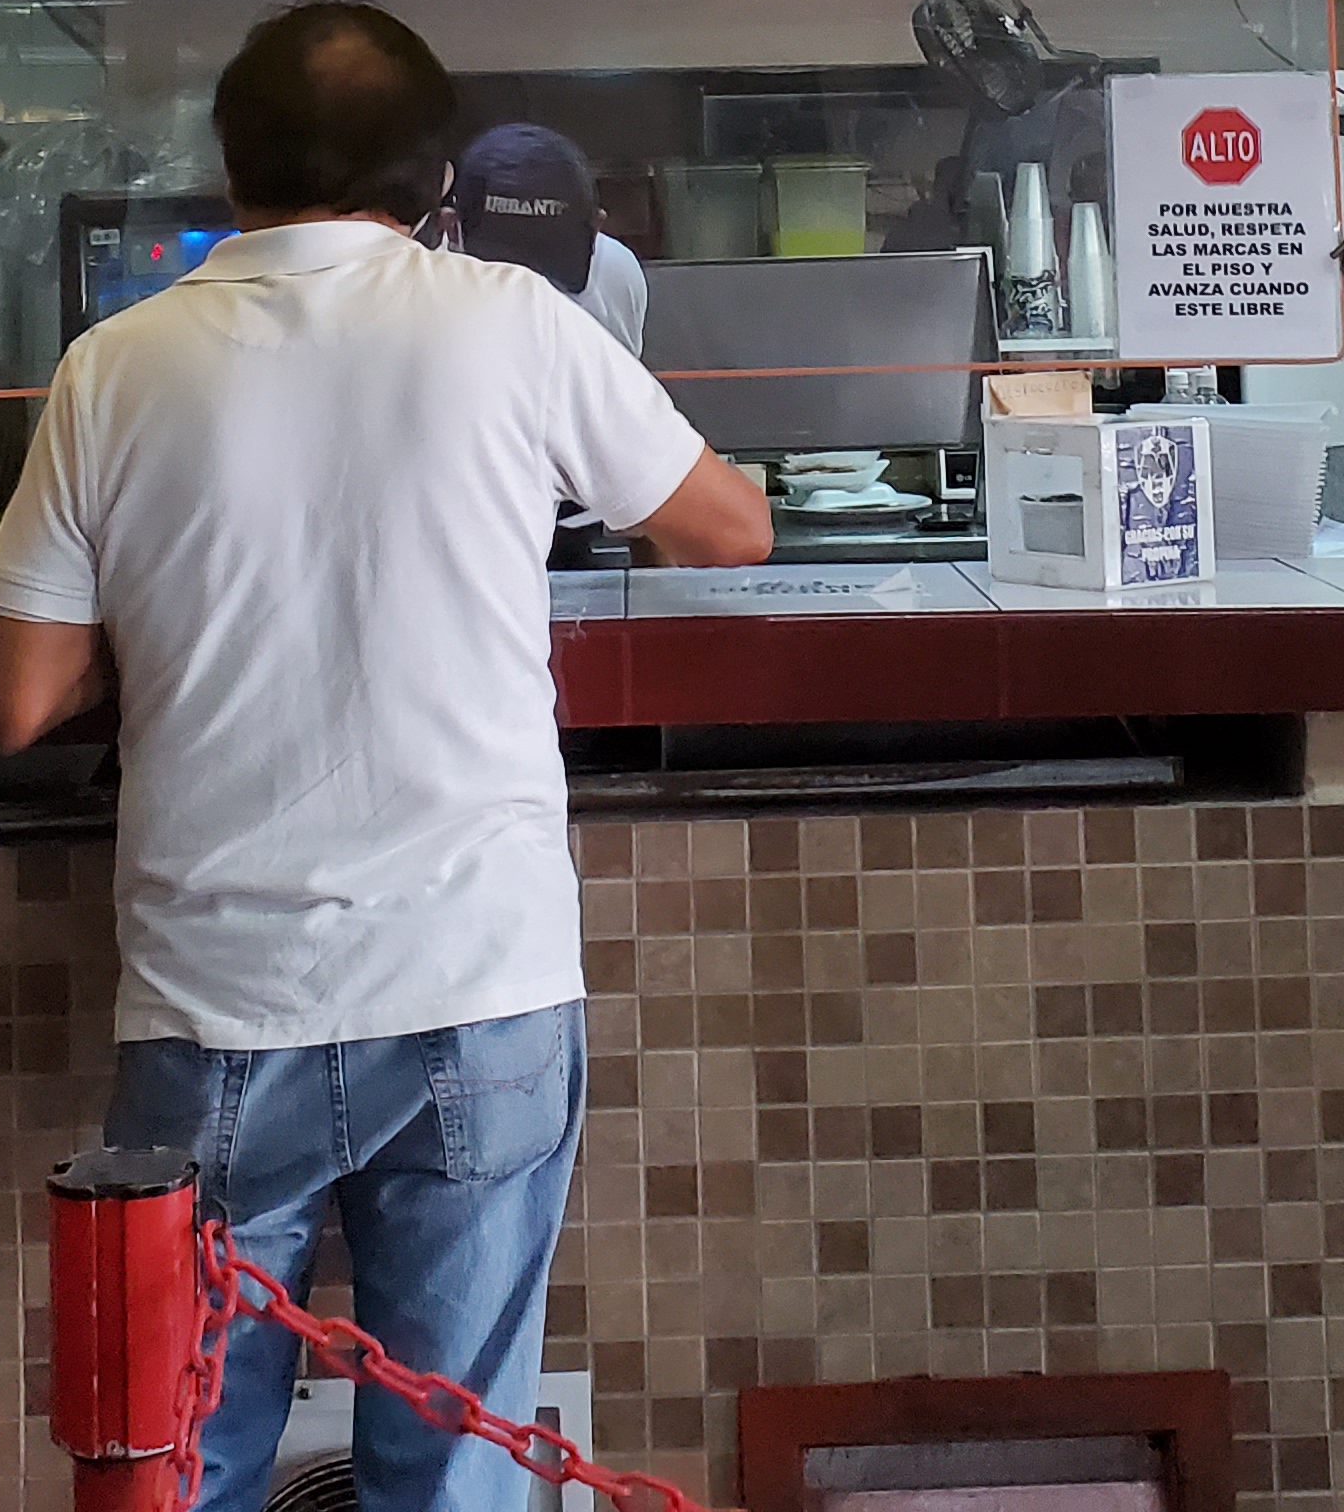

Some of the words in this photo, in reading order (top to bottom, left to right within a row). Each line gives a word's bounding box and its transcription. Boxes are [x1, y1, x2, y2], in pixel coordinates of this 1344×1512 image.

[1190, 131, 1255, 163] ALTO
[1160, 204, 1197, 216] POR
[1204, 203, 1292, 216] NUESTRA
[1149, 224, 1214, 238] SALUD,
[1222, 223, 1305, 236] RESPETA
[1152, 244, 1186, 256] LAS
[1194, 243, 1271, 256] MARCAS
[1278, 243, 1302, 255] EN
[1183, 263, 1205, 276] EL
[1212, 263, 1254, 276] PISO
[1261, 263, 1272, 275] Y
[1149, 283, 1224, 296] AVANZA
[1230, 282, 1308, 295] CUANDO
[1176, 303, 1222, 316] ESTE
[1229, 303, 1284, 315] LIBRE
